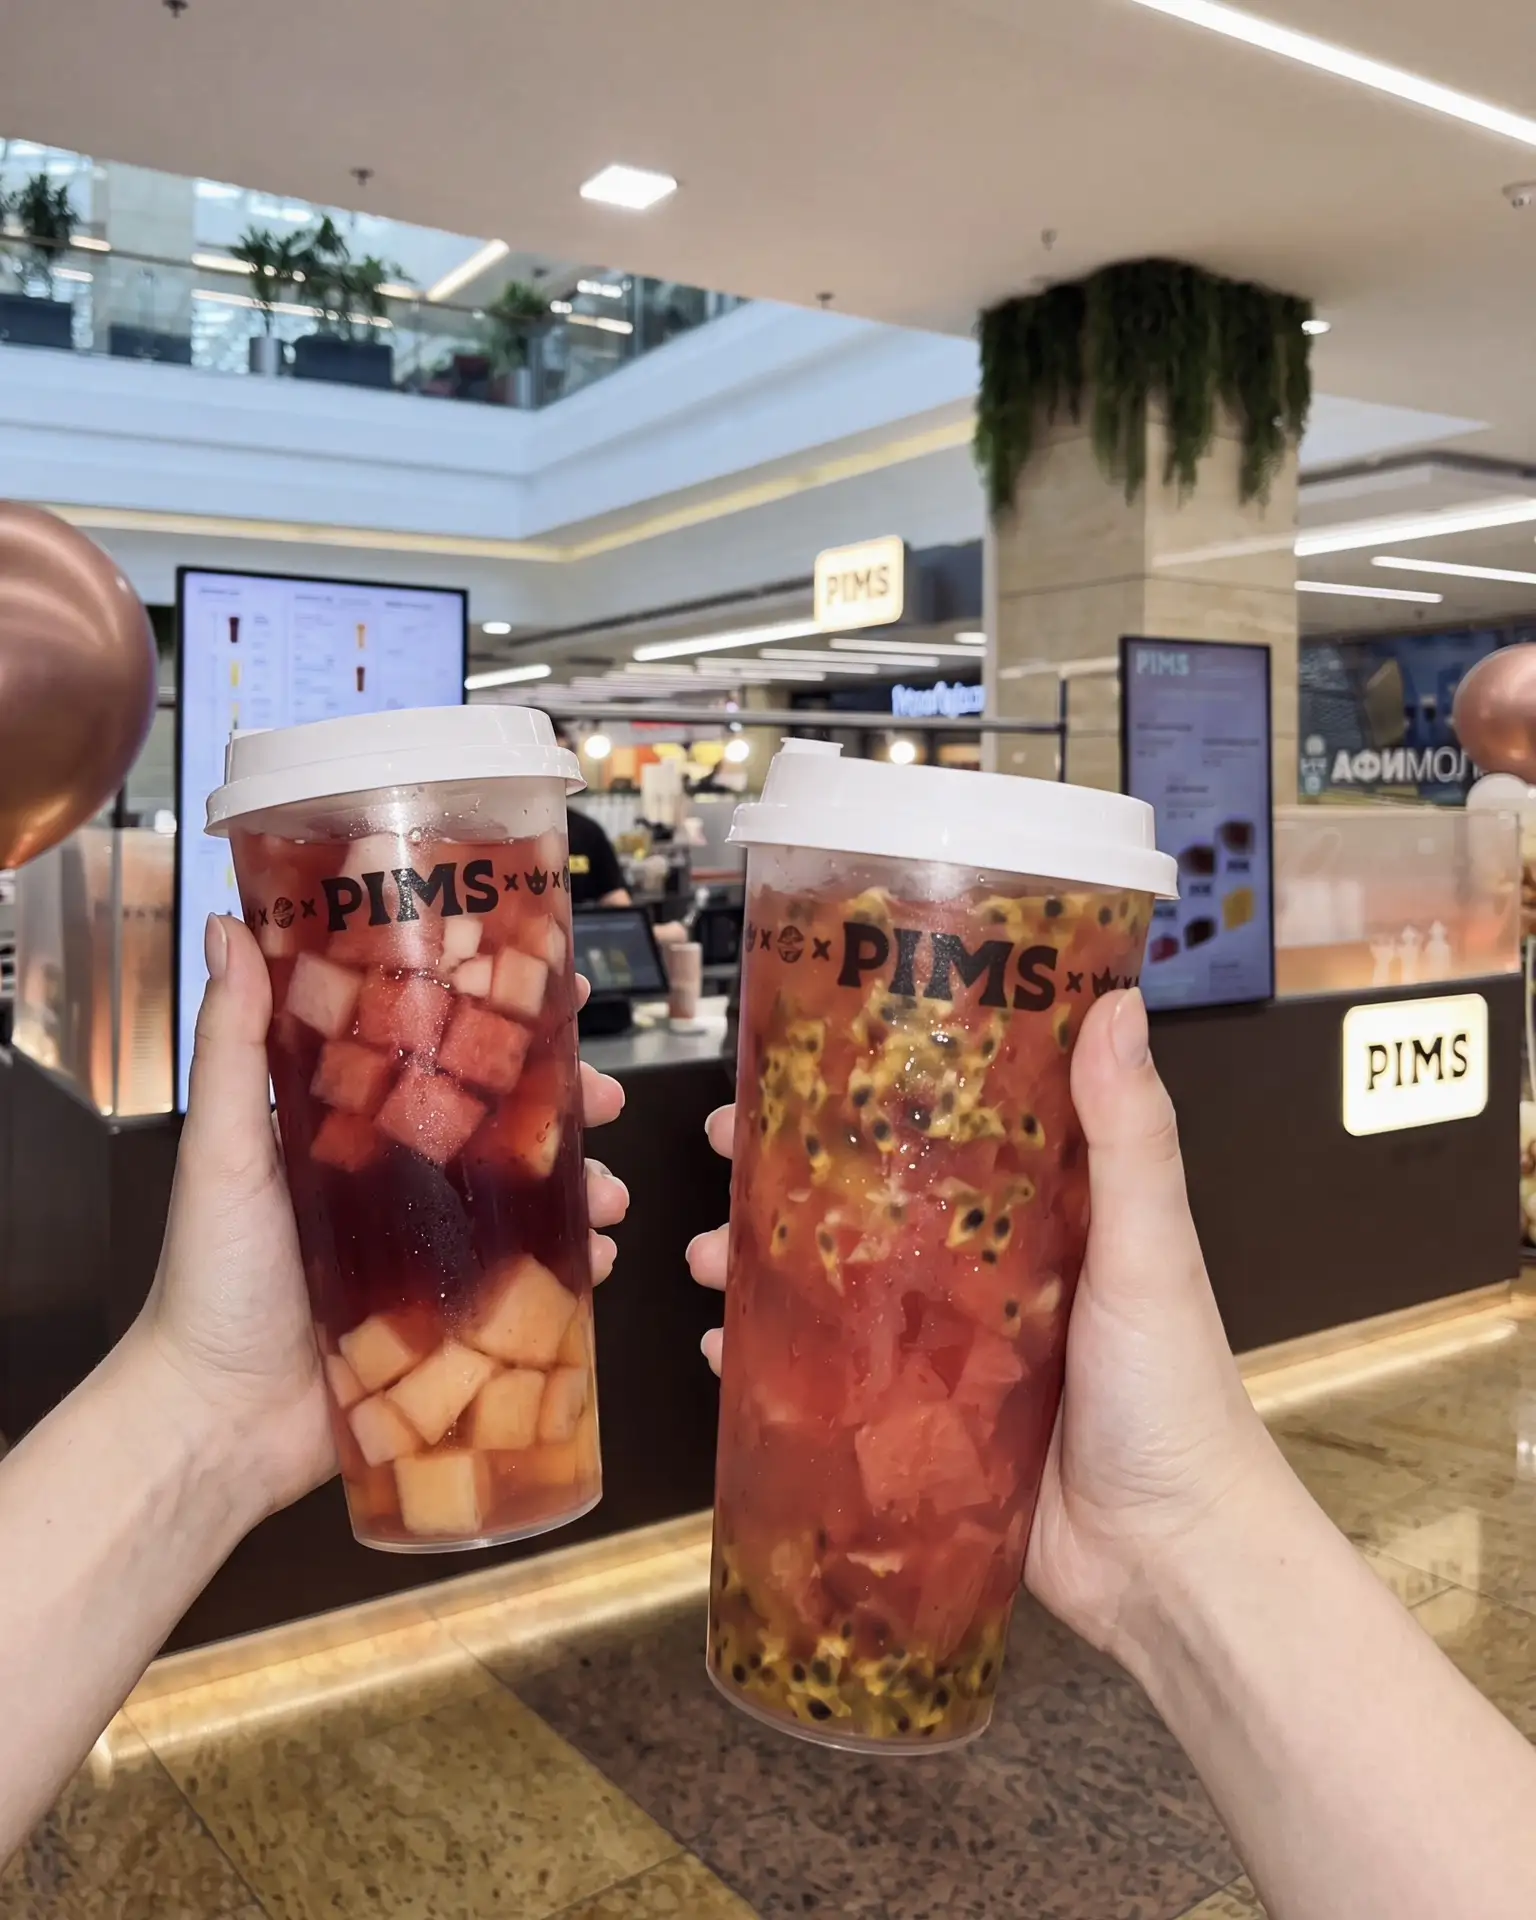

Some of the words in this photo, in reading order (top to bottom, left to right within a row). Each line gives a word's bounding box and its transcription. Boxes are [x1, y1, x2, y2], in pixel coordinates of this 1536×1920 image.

[827, 566, 890, 606] PIMS
[1136, 649, 1189, 676] PIMS
[1331, 746, 1484, 783] АФИМОЛ
[321, 859, 499, 932] PIMS
[838, 921, 1058, 1012] PIMS
[1368, 1034, 1467, 1090] PIMS
